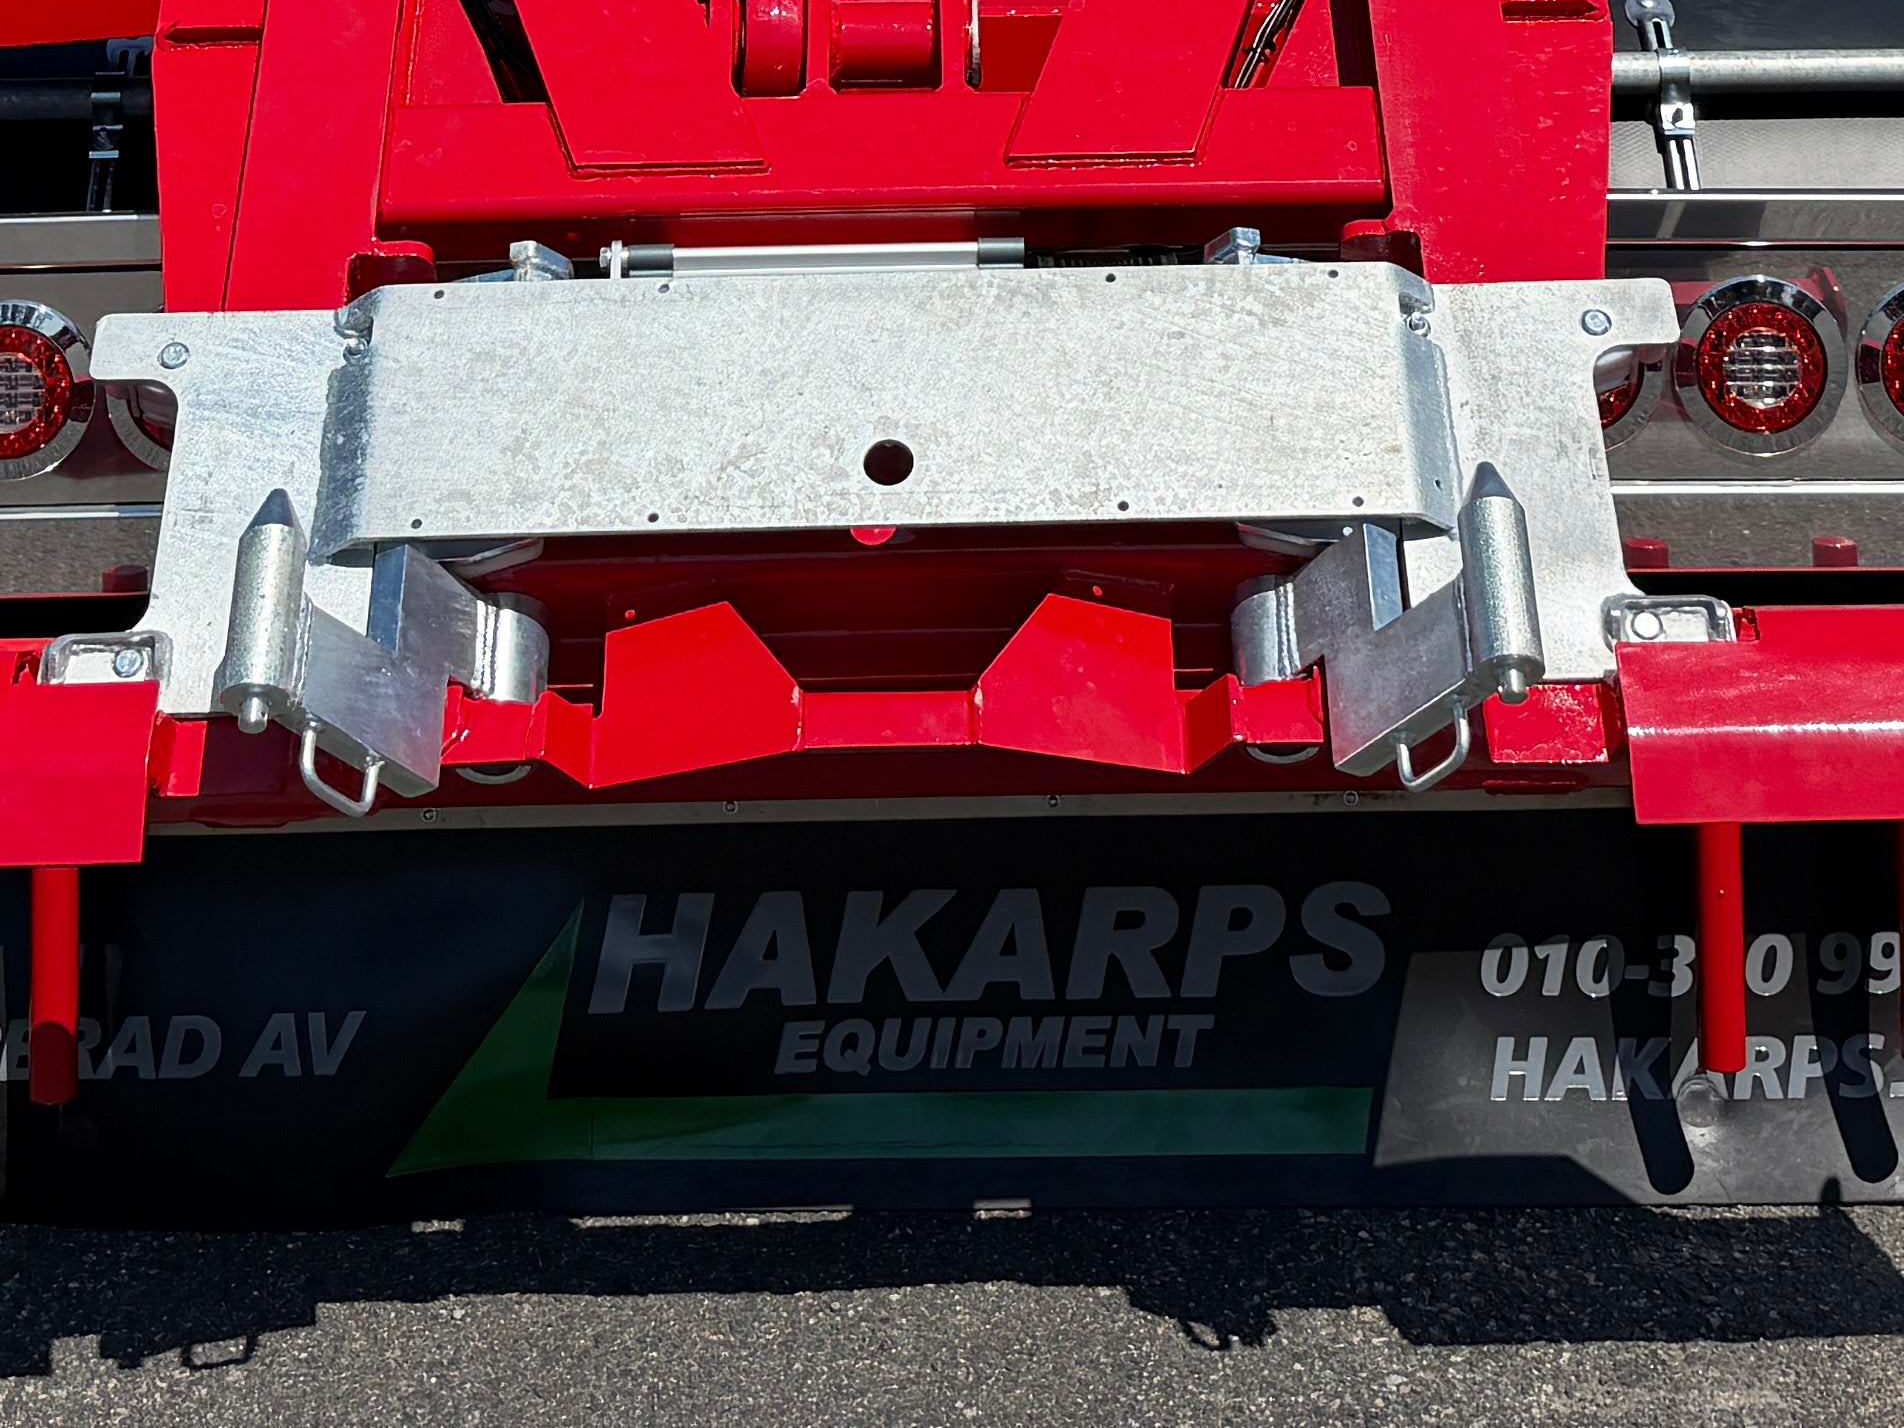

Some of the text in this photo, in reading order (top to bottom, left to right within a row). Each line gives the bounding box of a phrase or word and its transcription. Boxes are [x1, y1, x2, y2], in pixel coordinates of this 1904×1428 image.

[587, 881, 1392, 1014] HAKARPS
[1480, 932, 1794, 997] 010-30
[238, 1010, 366, 1080] AV
[774, 1013, 1215, 1076] EQUIPMENT
